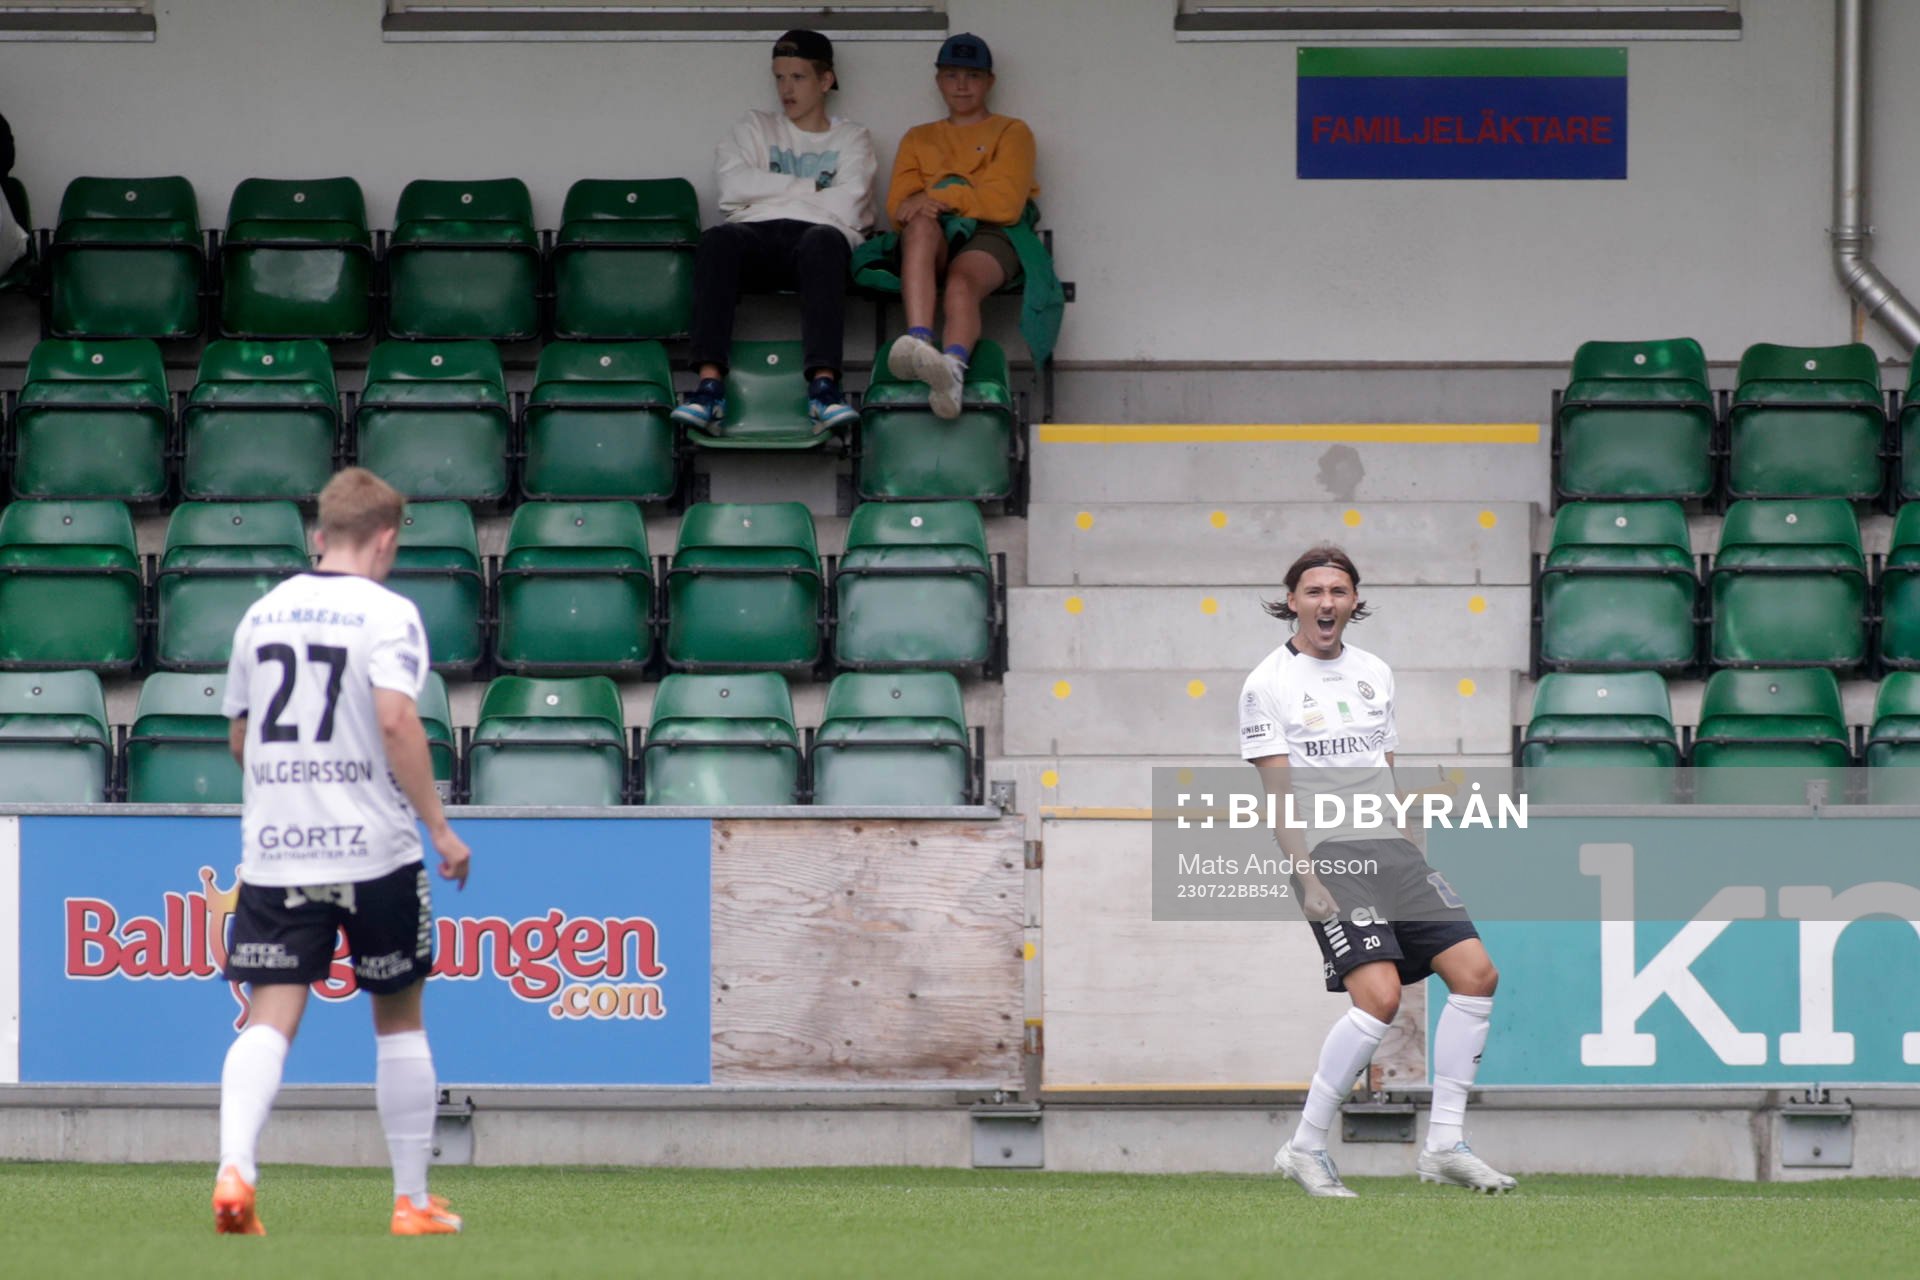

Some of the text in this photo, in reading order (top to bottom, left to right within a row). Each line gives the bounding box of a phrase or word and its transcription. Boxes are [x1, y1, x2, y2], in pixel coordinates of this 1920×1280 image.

[256, 642, 348, 743] 27
[1240, 723, 1272, 736] UNIBET
[258, 824, 368, 850] GÖRTZ
[1363, 934, 1382, 950] 20
[550, 984, 667, 1018] .com
